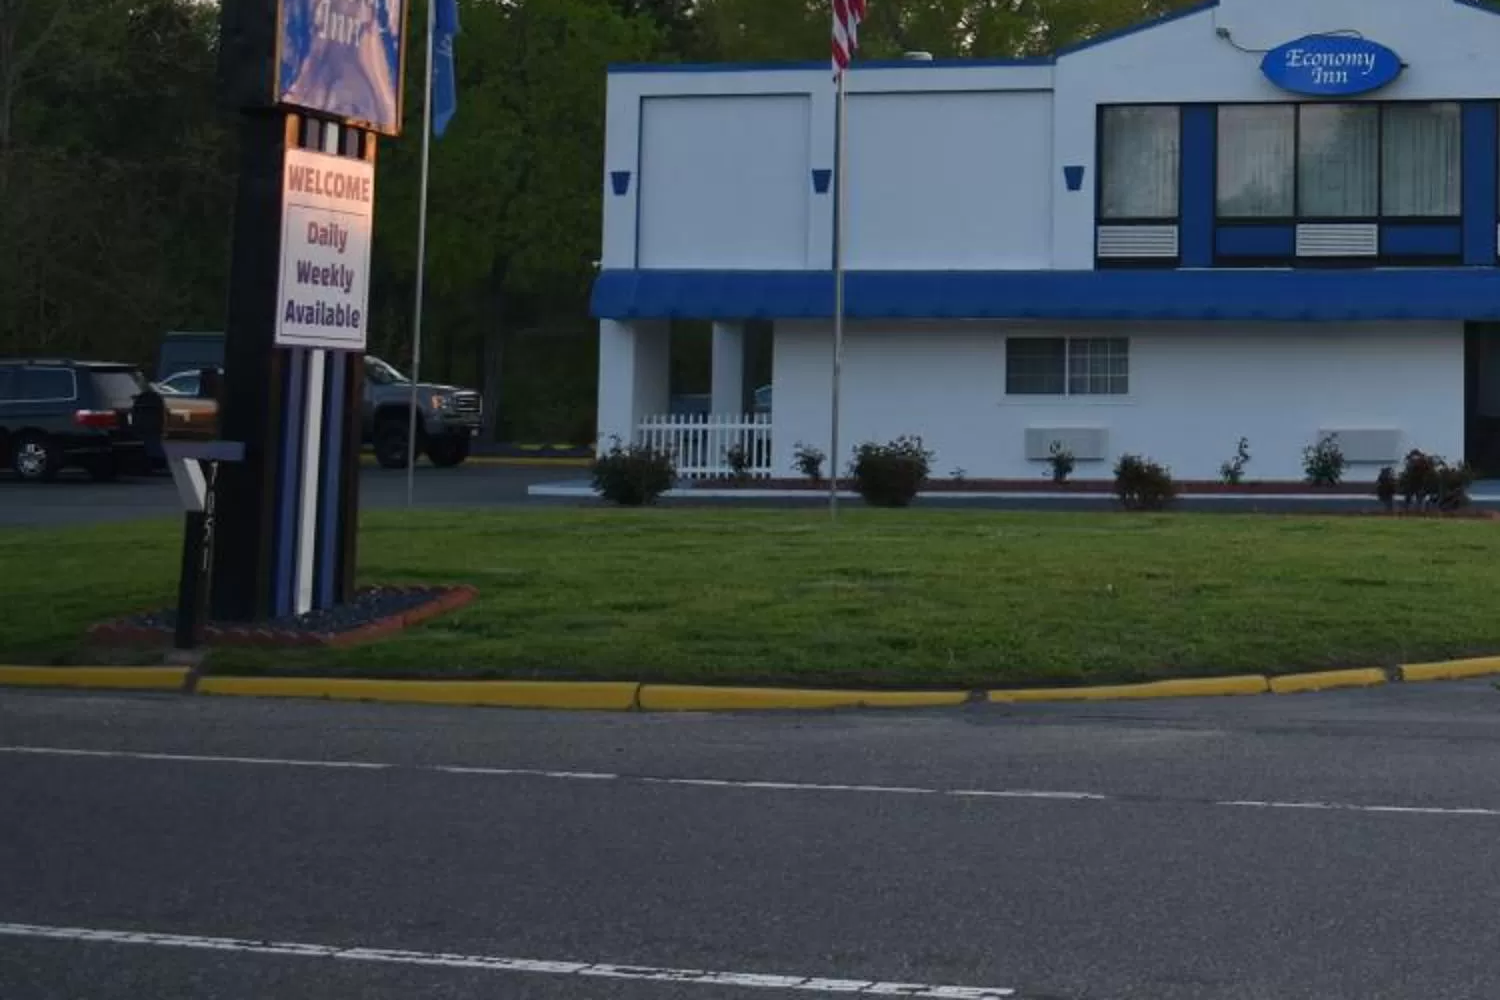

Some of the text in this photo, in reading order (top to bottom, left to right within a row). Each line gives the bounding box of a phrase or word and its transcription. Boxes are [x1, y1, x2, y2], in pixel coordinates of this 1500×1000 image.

[1285, 48, 1376, 75] Economy
[1311, 67, 1349, 85] Inn
[288, 163, 371, 203] WELCOME
[307, 220, 350, 254] Daily
[296, 259, 355, 294] Weekly
[284, 299, 361, 330] Available
